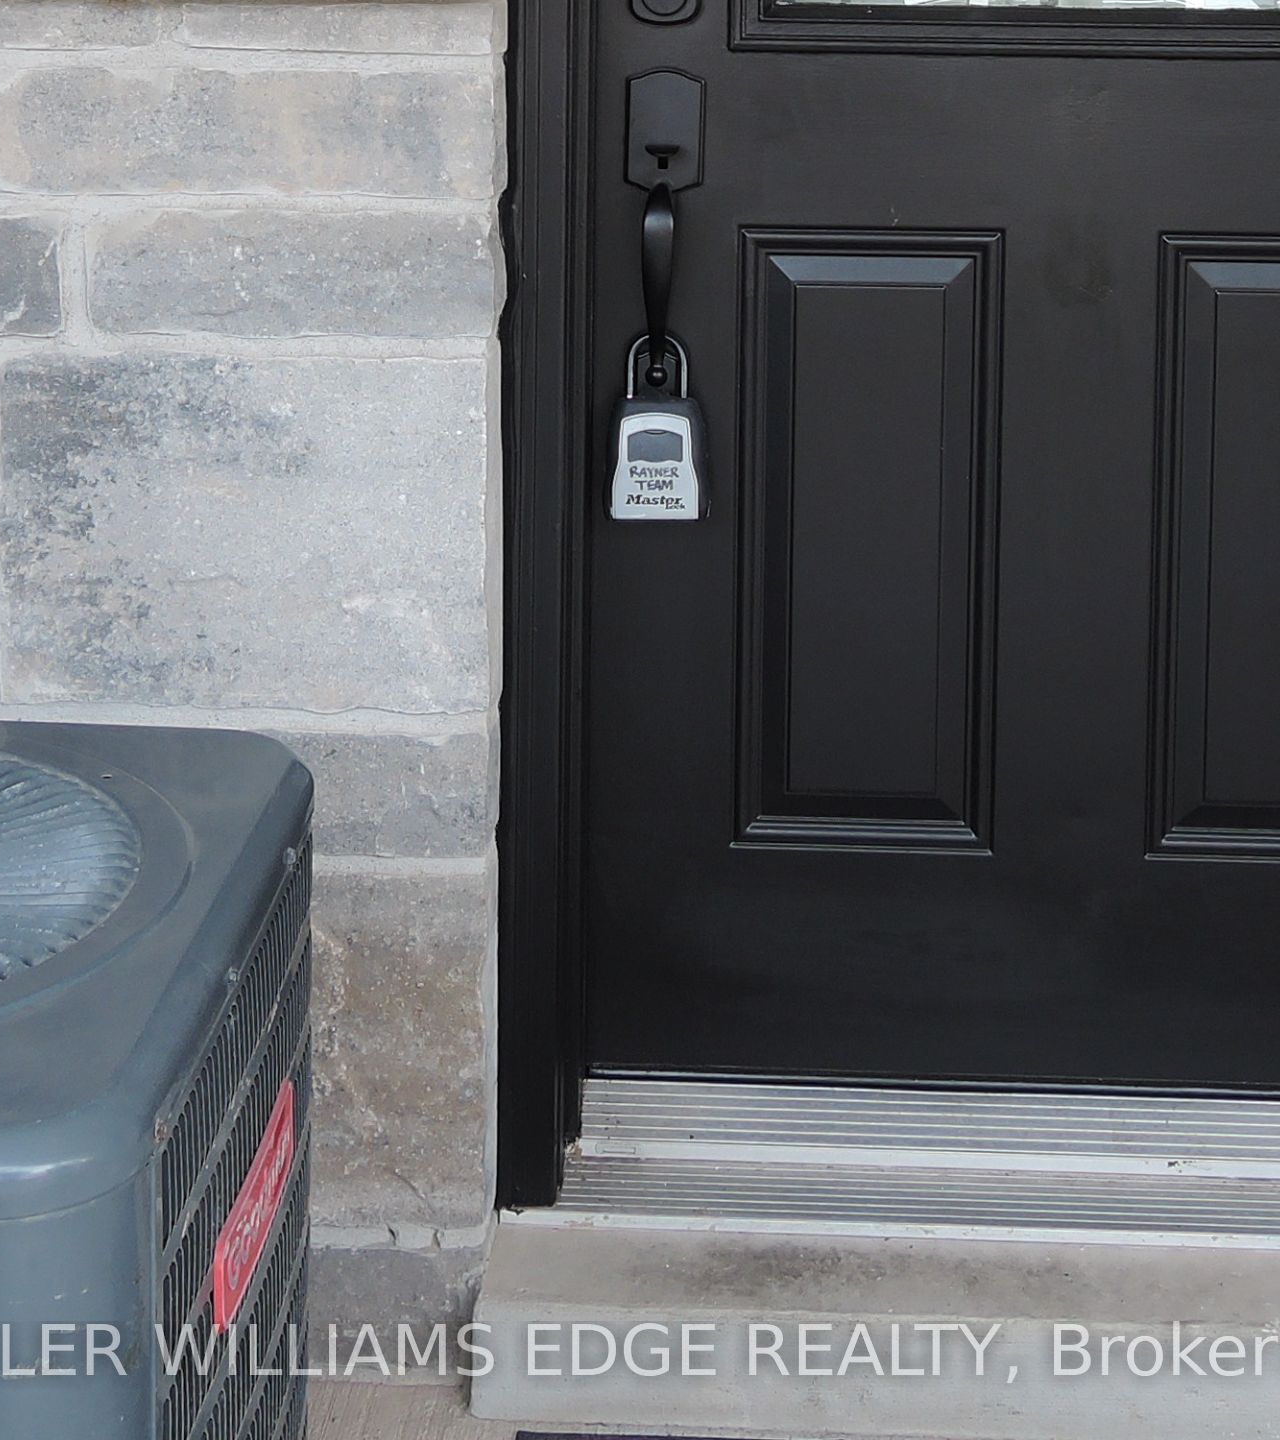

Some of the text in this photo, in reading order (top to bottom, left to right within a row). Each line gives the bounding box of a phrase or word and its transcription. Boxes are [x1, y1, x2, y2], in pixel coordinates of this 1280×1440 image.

[629, 465, 679, 478] RAYNER
[634, 479, 673, 491] TEAM
[625, 494, 683, 505] Master
